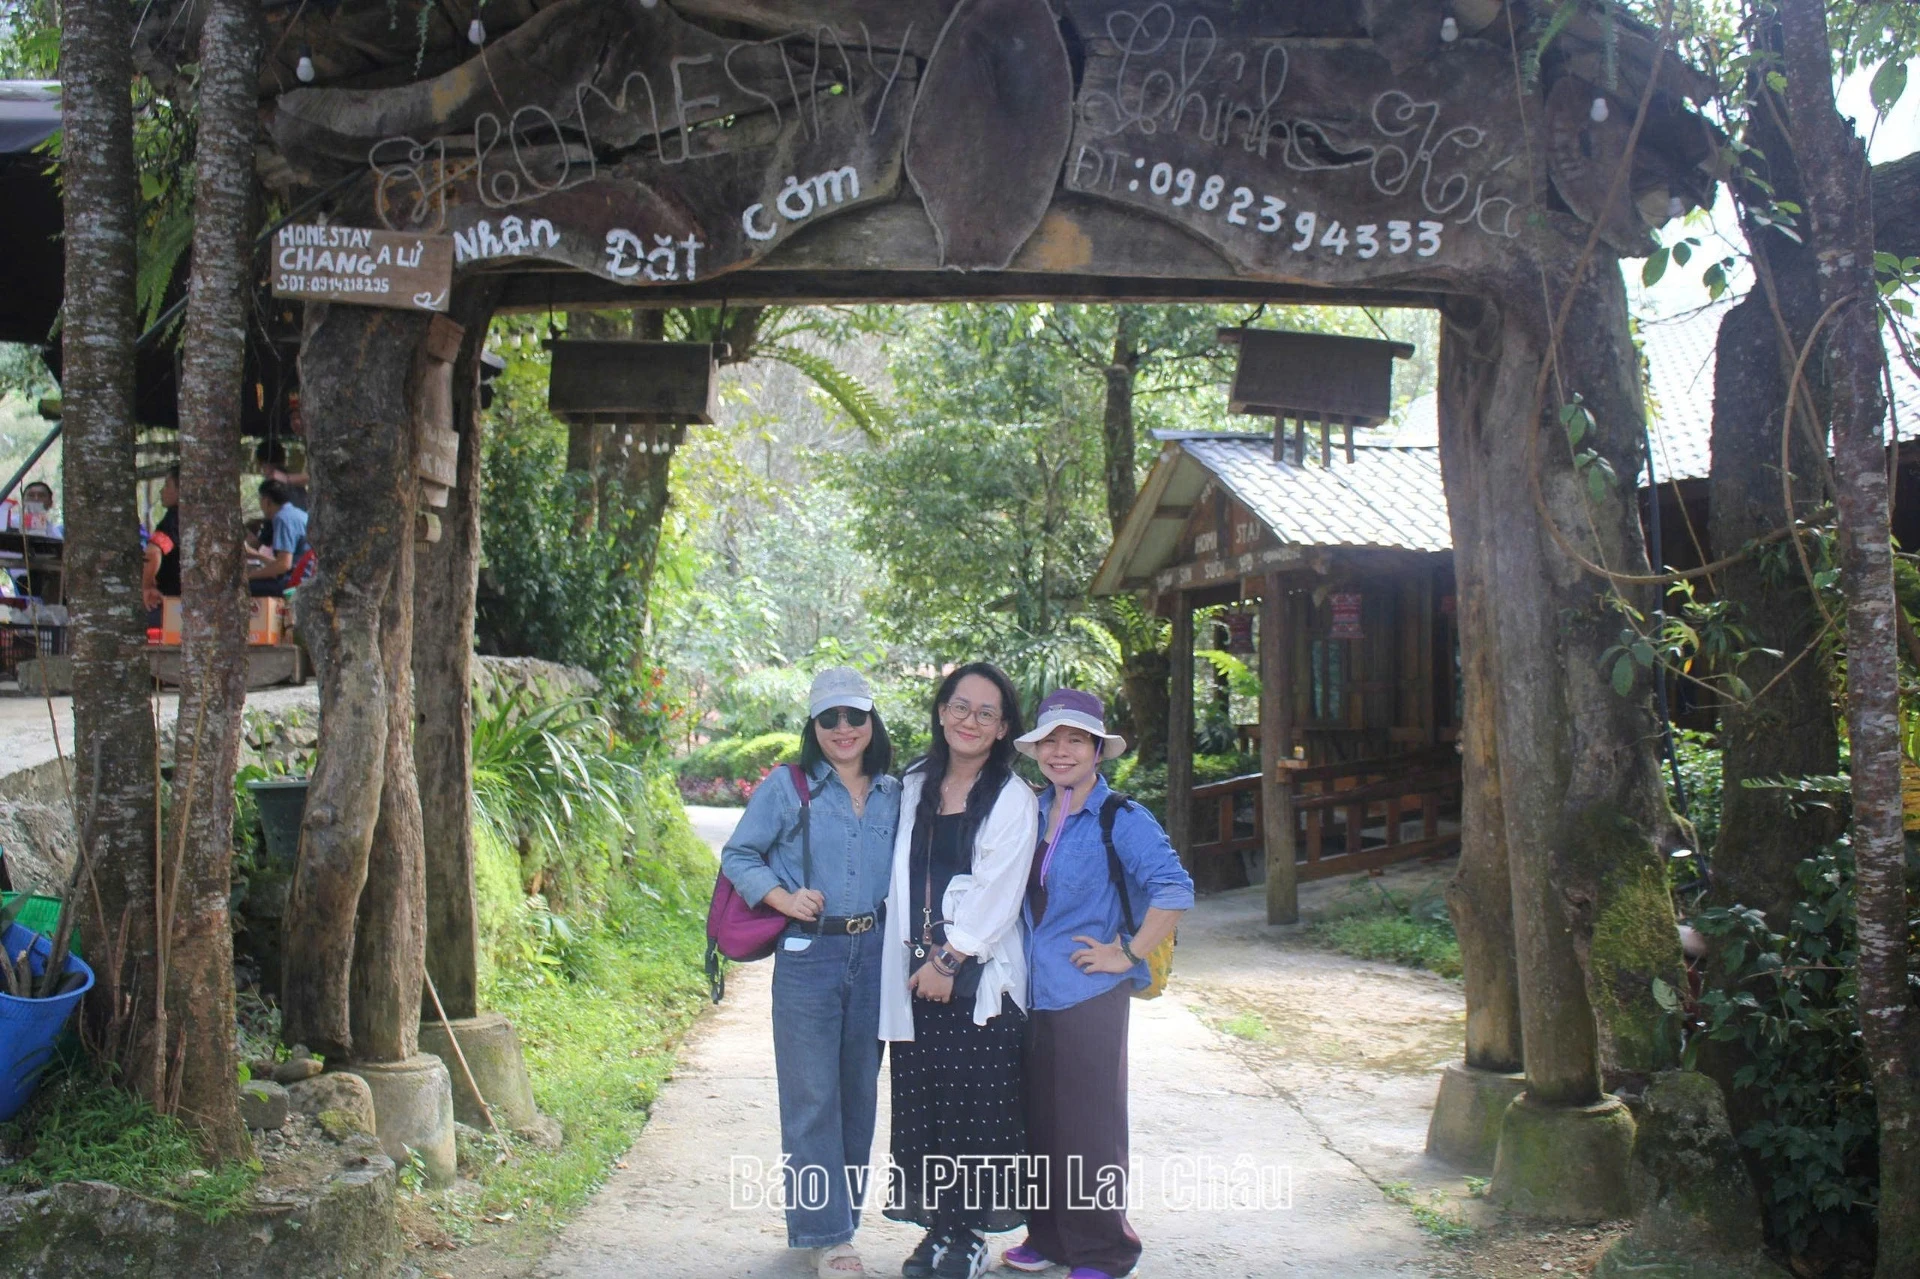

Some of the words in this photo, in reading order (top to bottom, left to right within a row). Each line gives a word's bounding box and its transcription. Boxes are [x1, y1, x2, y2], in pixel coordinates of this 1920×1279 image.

[278, 225, 372, 248] HOMESTAY
[279, 247, 377, 275] CHANG
[377, 245, 391, 265] A
